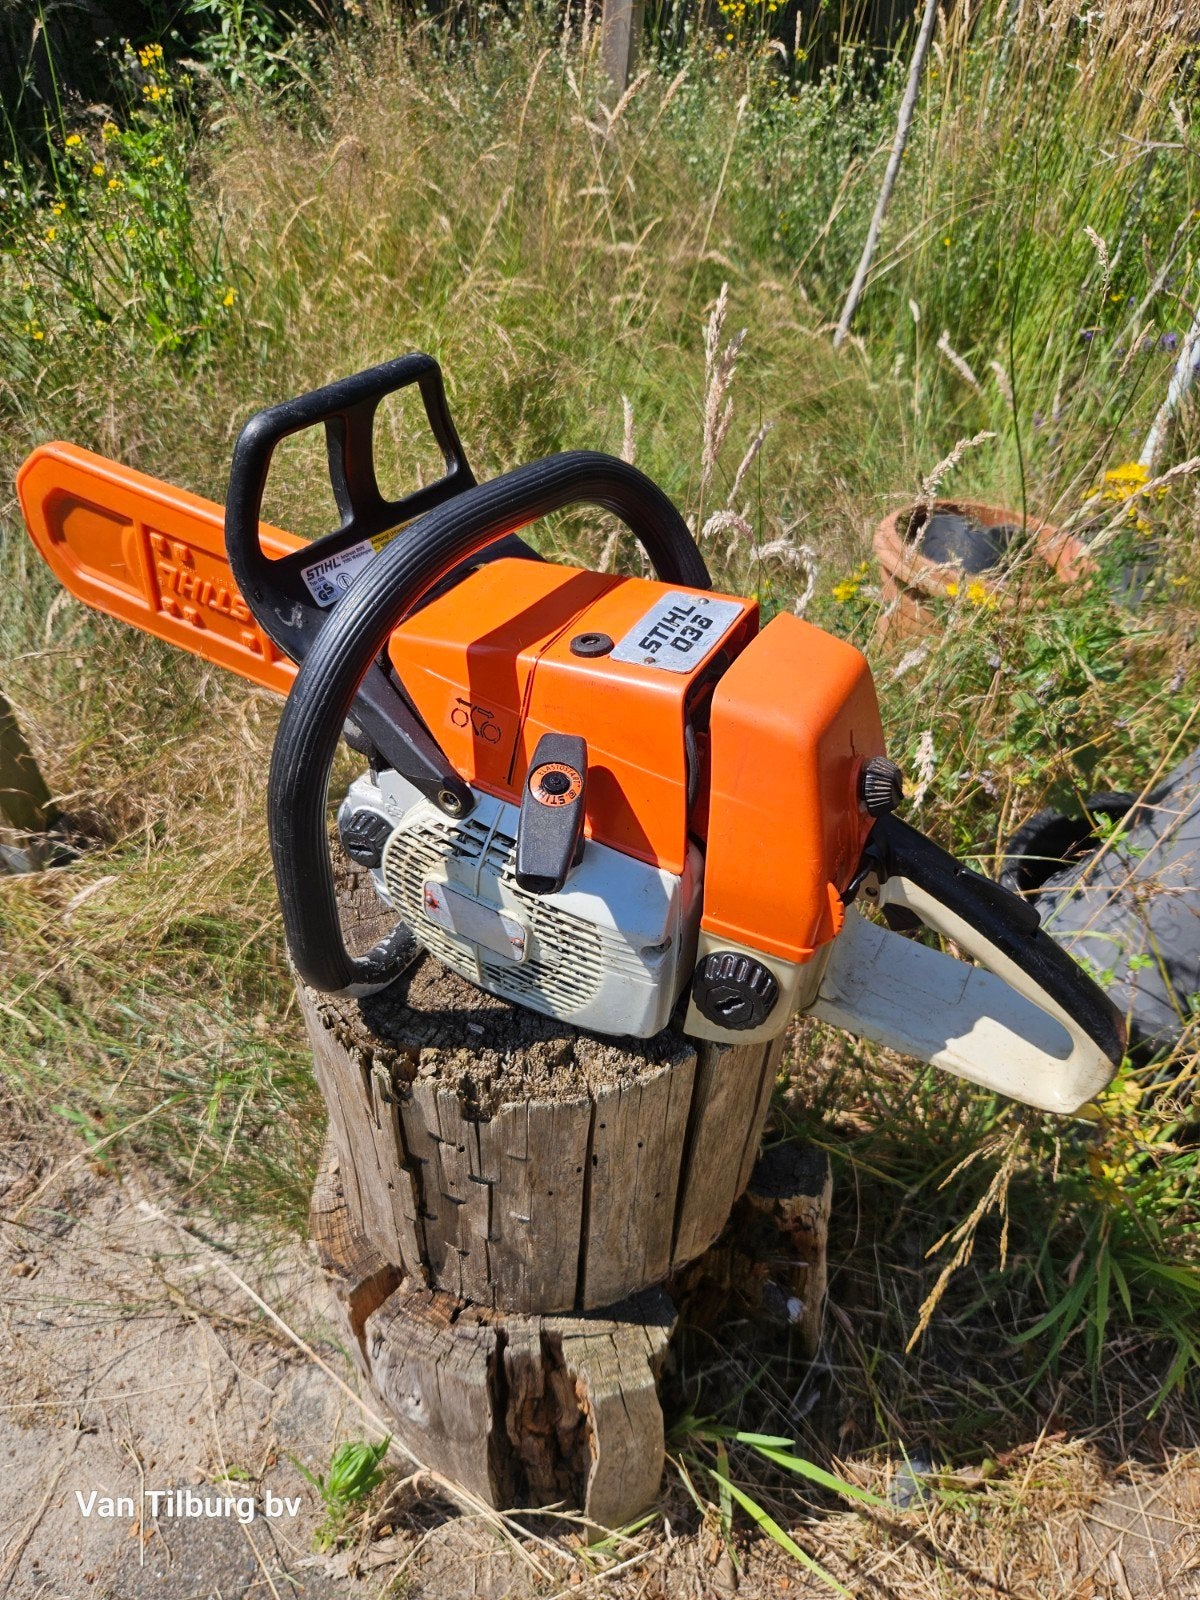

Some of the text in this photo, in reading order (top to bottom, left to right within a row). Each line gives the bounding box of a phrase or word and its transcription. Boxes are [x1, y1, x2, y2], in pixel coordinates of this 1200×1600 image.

[306, 558, 342, 581] STIHL
[157, 561, 251, 622] STIHL
[318, 583, 335, 602] GS
[638, 605, 696, 654] STIHL
[670, 614, 714, 653] 038
